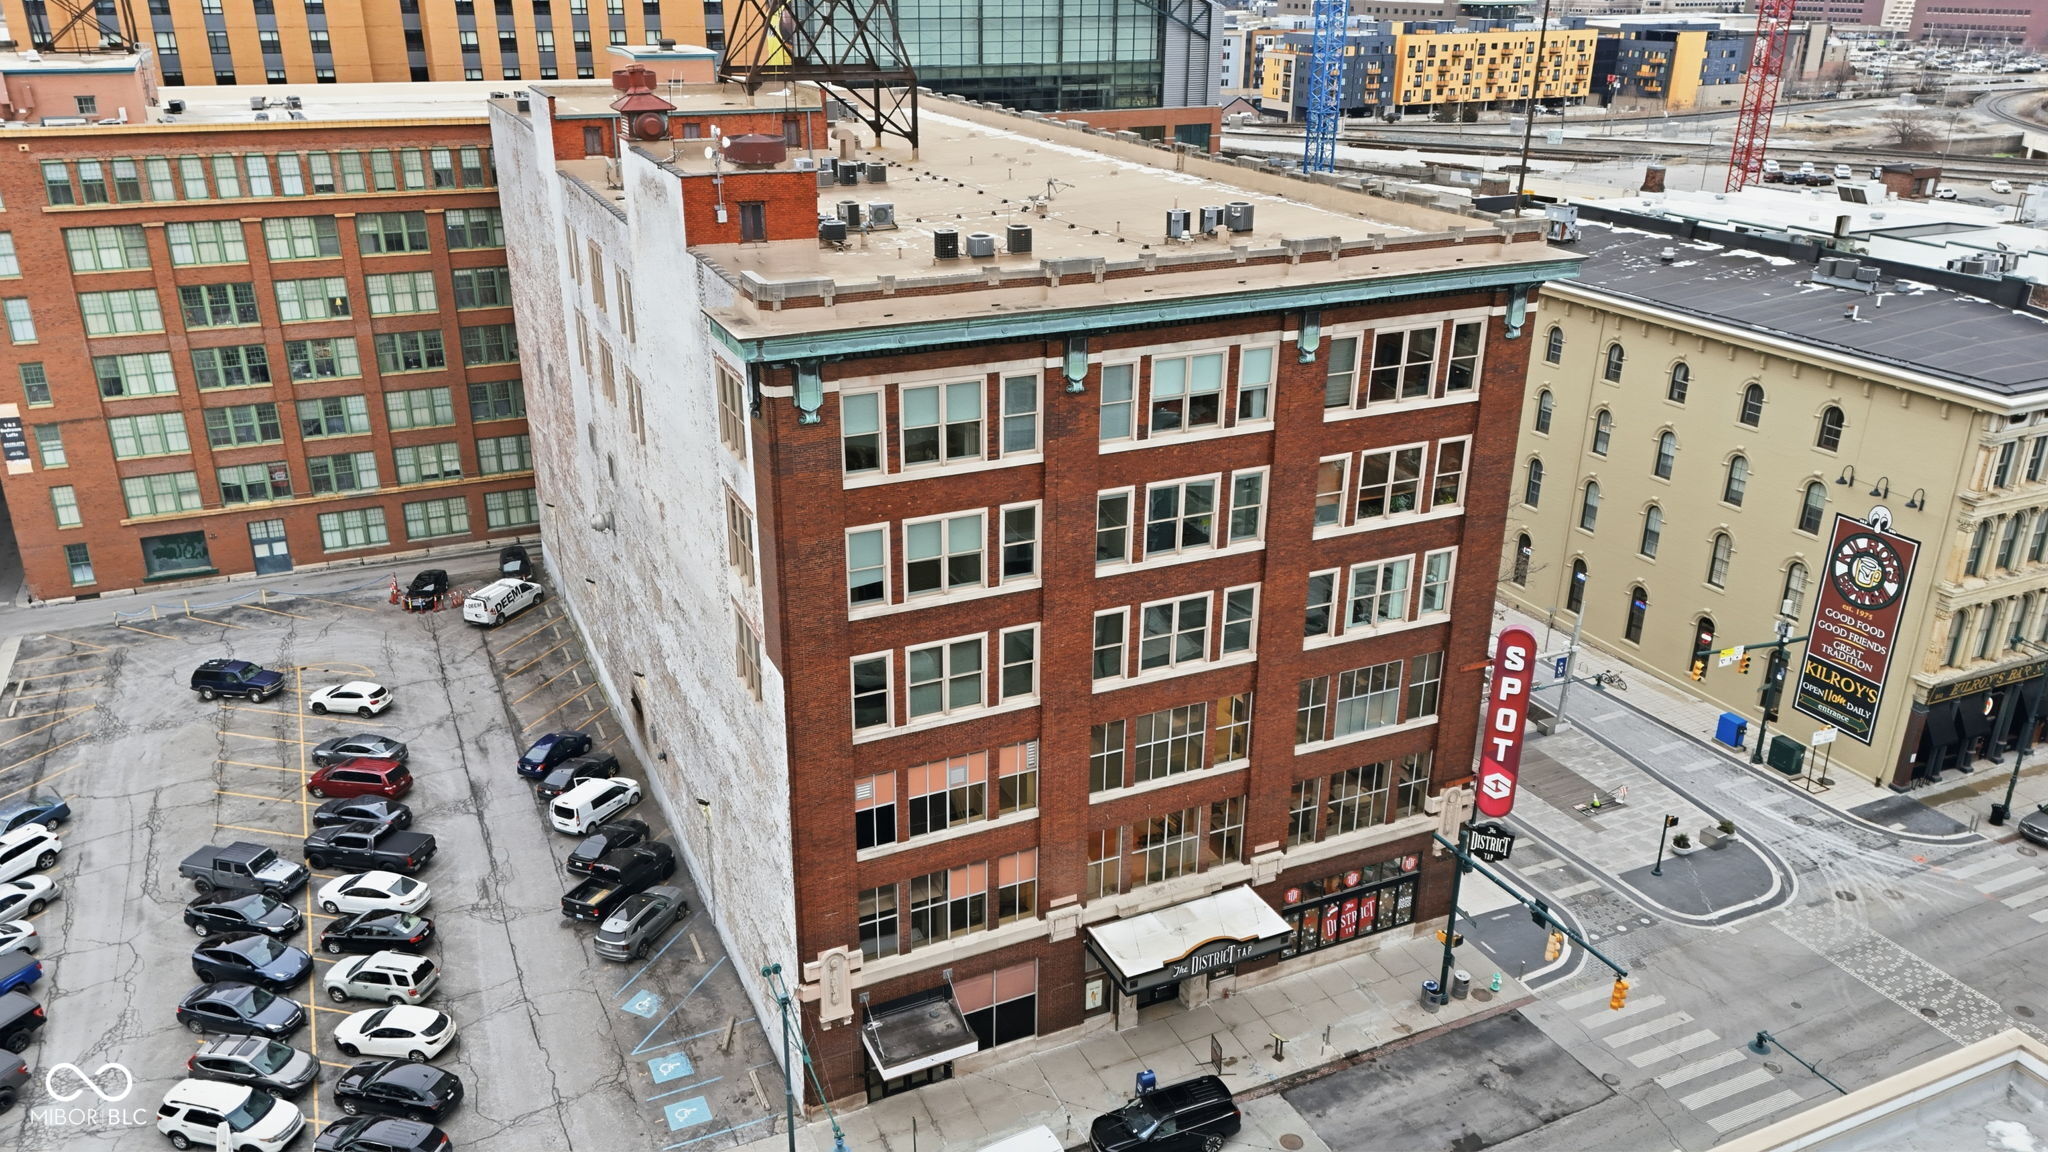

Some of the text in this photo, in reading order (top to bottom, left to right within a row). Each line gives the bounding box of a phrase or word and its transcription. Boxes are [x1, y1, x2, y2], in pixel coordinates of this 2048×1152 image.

[495, 586, 521, 613] DEEM
[1856, 609, 1874, 620] 1975
[1818, 620, 1887, 655] GOOD FRIENDS
[1825, 608, 1885, 638] GOOD FOOD
[1822, 643, 1873, 673] TRADITION
[1833, 641, 1863, 659] GREAT
[1805, 660, 1878, 703] KILROY'S
[1493, 645, 1526, 762] SPOT
[1802, 681, 1824, 697] OPEN
[1846, 702, 1872, 720] DAILY
[1818, 704, 1850, 723] entrance
[1470, 831, 1511, 857] DISTRICT
[1484, 852, 1494, 861] TAP
[1326, 899, 1376, 937] DISTRICT
[1173, 965, 1189, 978] The
[1191, 945, 1236, 975] DISTRICT
[1237, 946, 1253, 959] TAP
